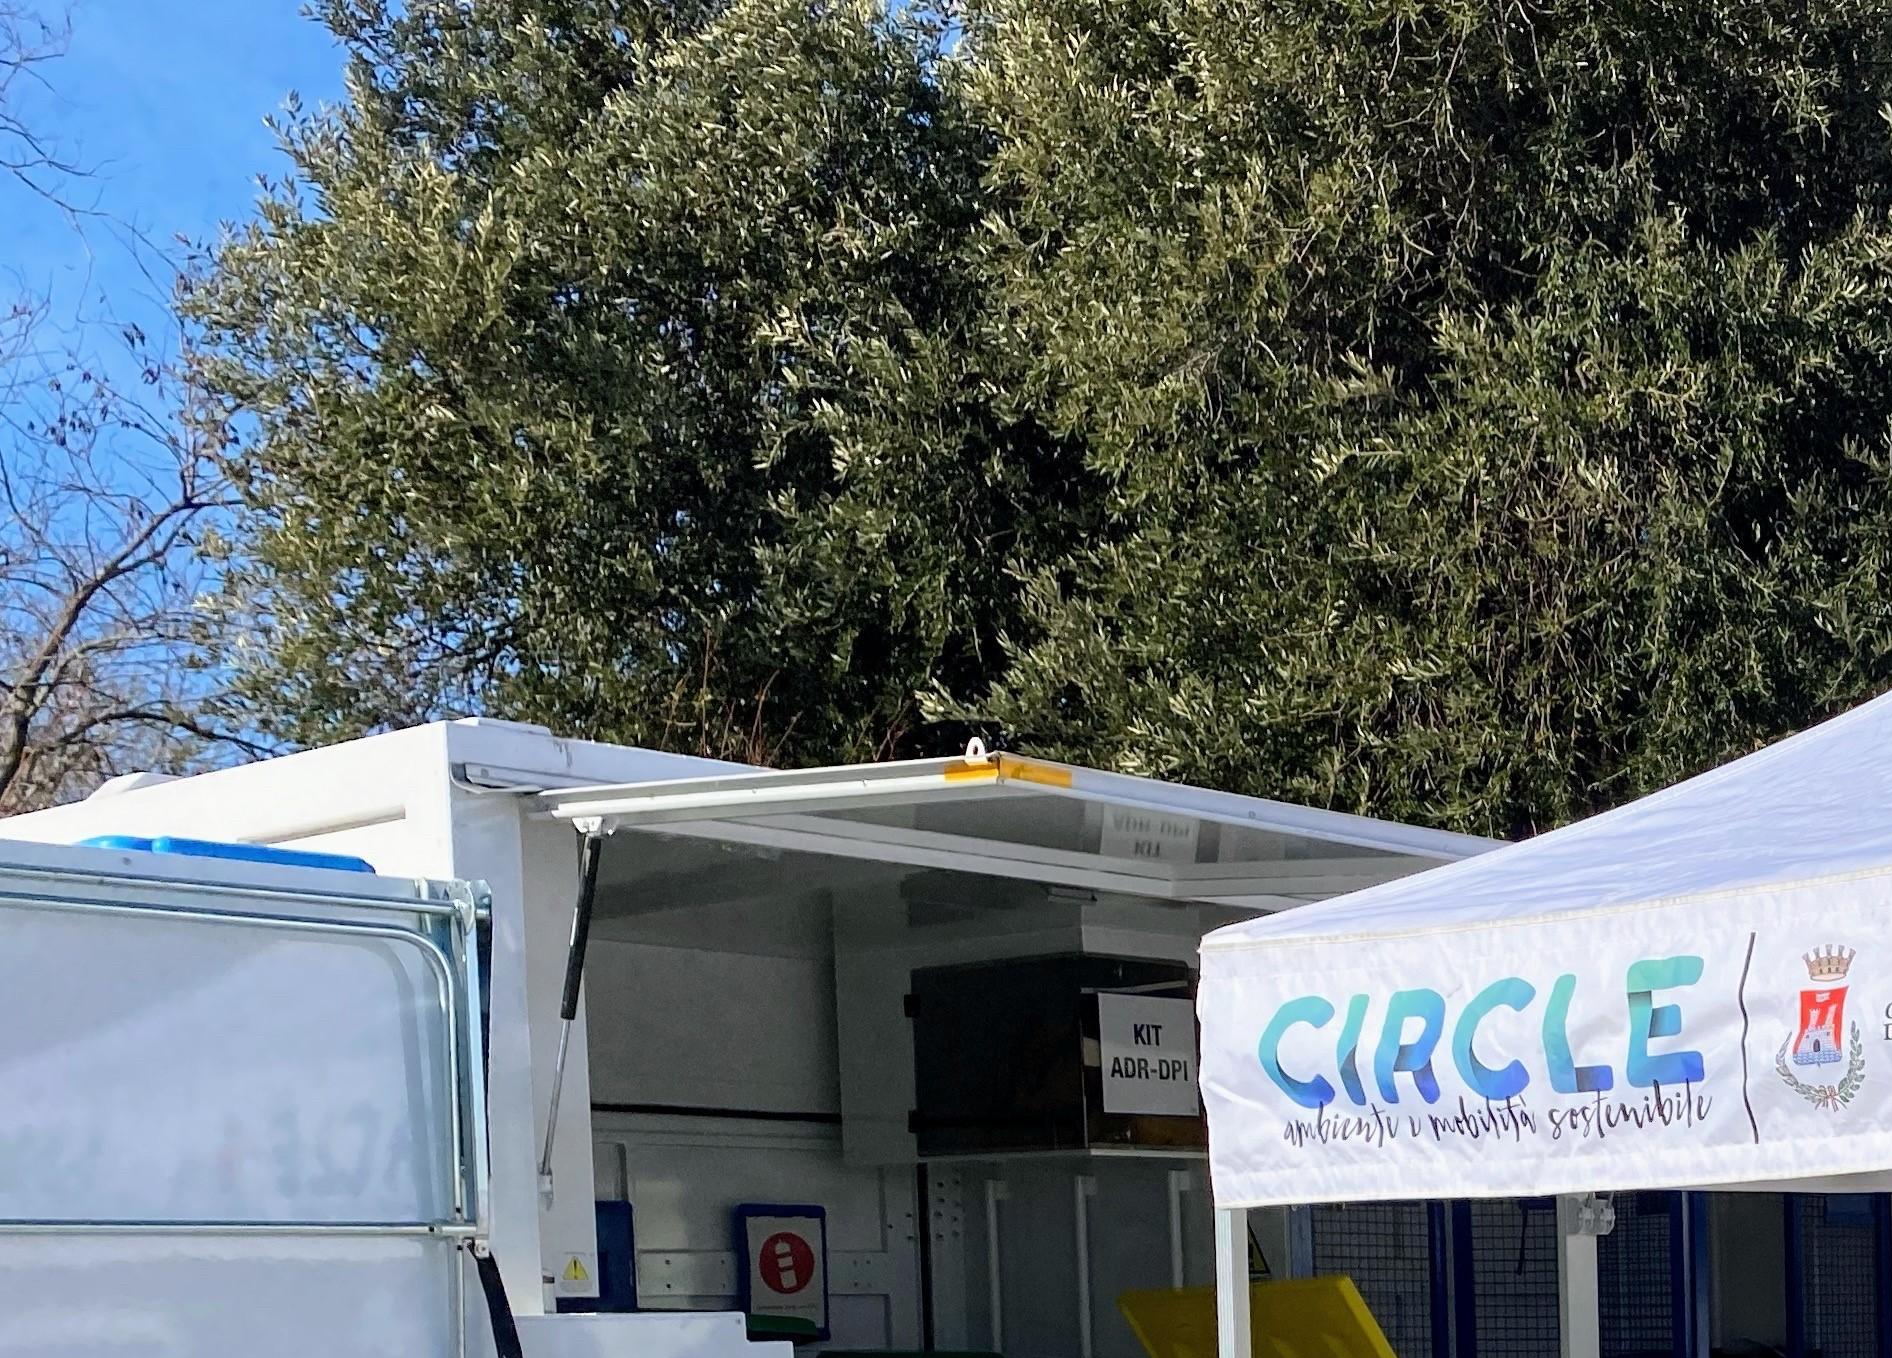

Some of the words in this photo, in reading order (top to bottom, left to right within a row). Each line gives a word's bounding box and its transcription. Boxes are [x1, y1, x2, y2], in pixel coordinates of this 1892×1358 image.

[1133, 1023, 1162, 1046] KIT
[1258, 955, 1705, 1108] CIRCLE
[1110, 1057, 1189, 1081] ADR-DPI
[1282, 1101, 1399, 1147] ambiente
[1429, 1095, 1537, 1143] mobilità
[1548, 1076, 1713, 1139] sostenibile
